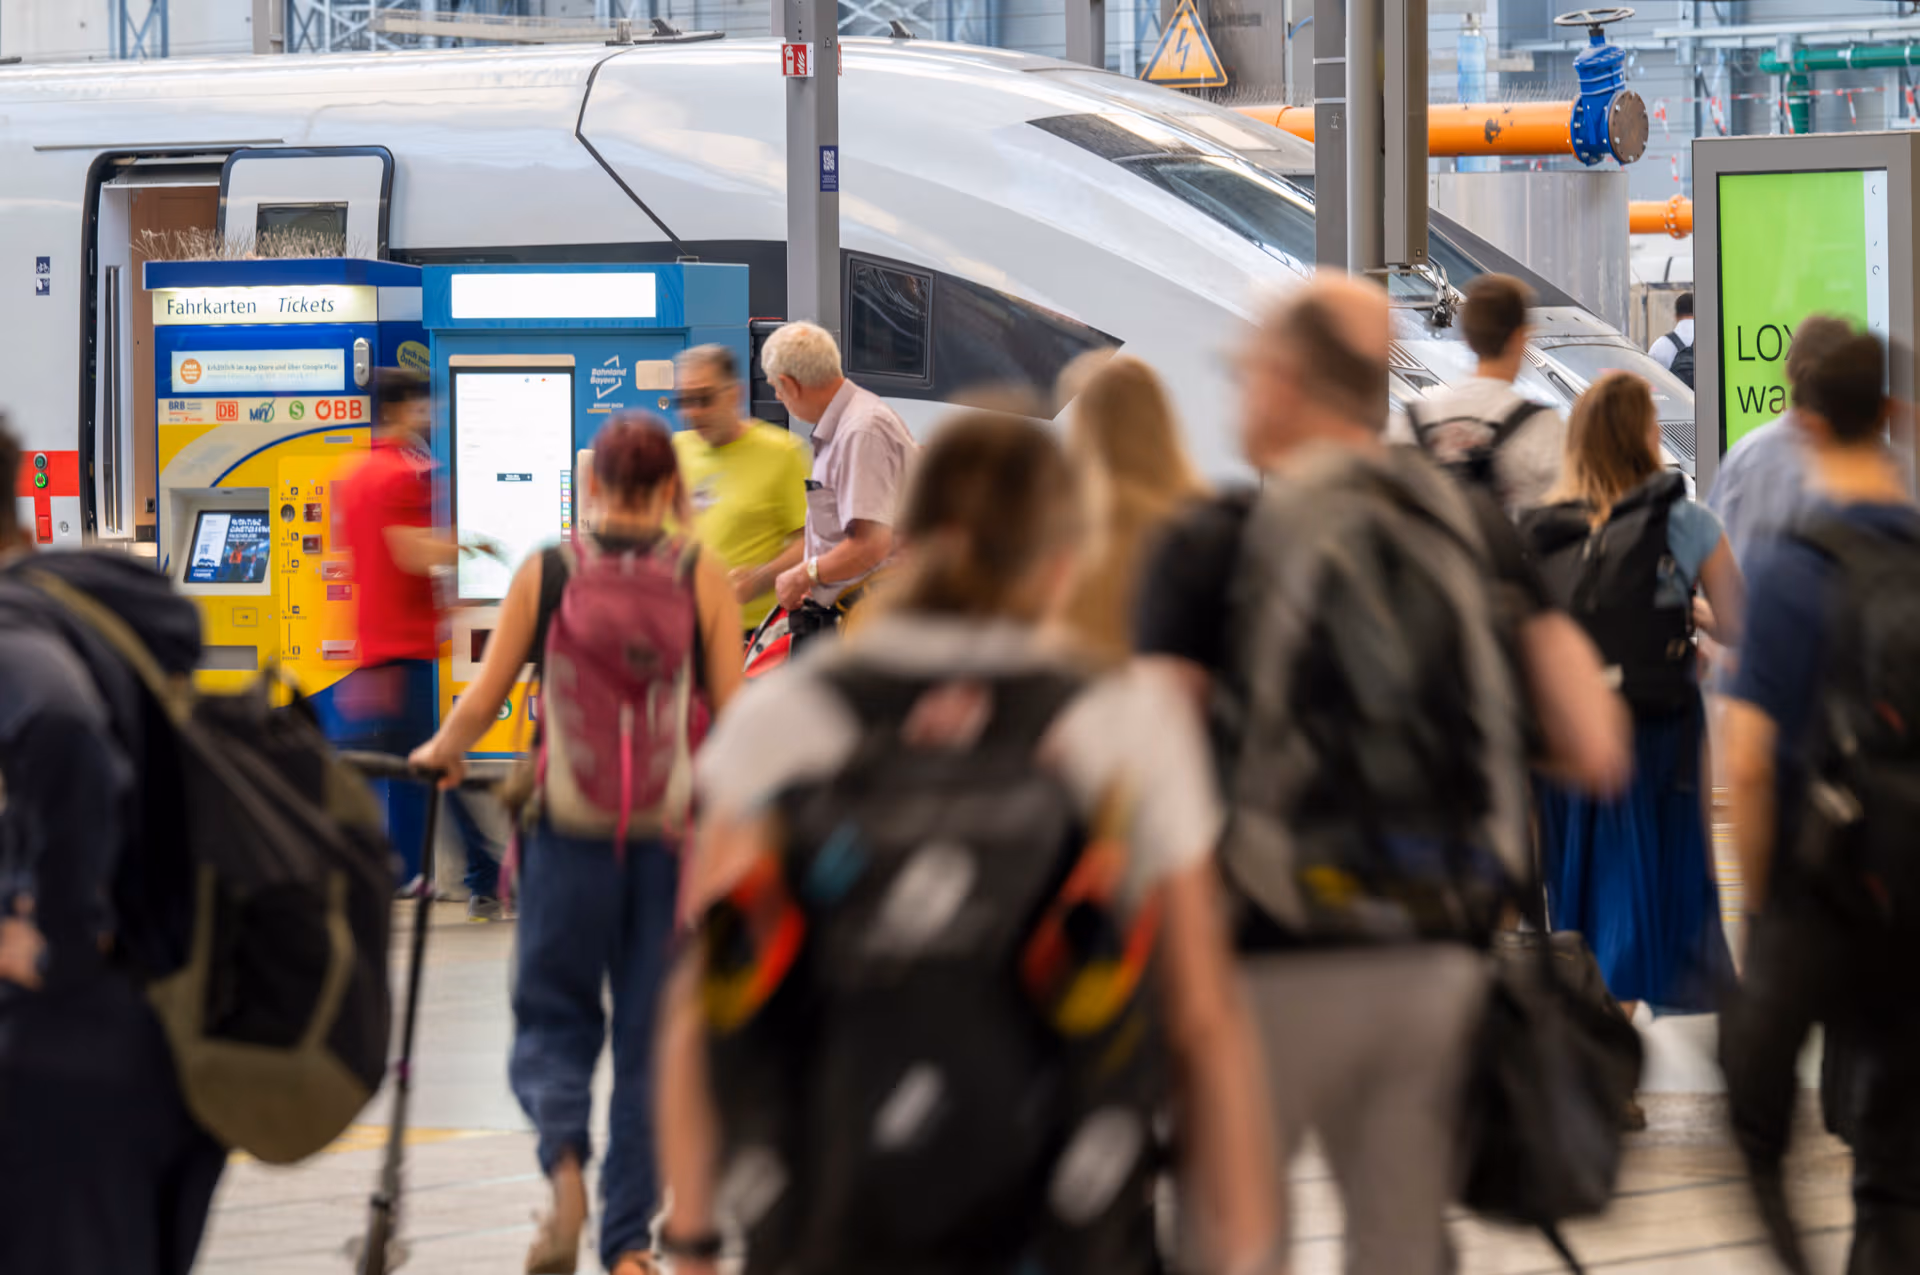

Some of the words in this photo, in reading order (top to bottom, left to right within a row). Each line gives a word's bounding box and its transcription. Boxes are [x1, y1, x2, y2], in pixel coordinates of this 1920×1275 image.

[167, 298, 257, 315] Fahrkarten
[278, 296, 335, 313] Tickets
[591, 367, 627, 377] Bahnland
[590, 376, 616, 385] Bayern
[168, 400, 186, 411] BRB
[217, 402, 237, 420] DB
[315, 399, 363, 420] ÖBB
